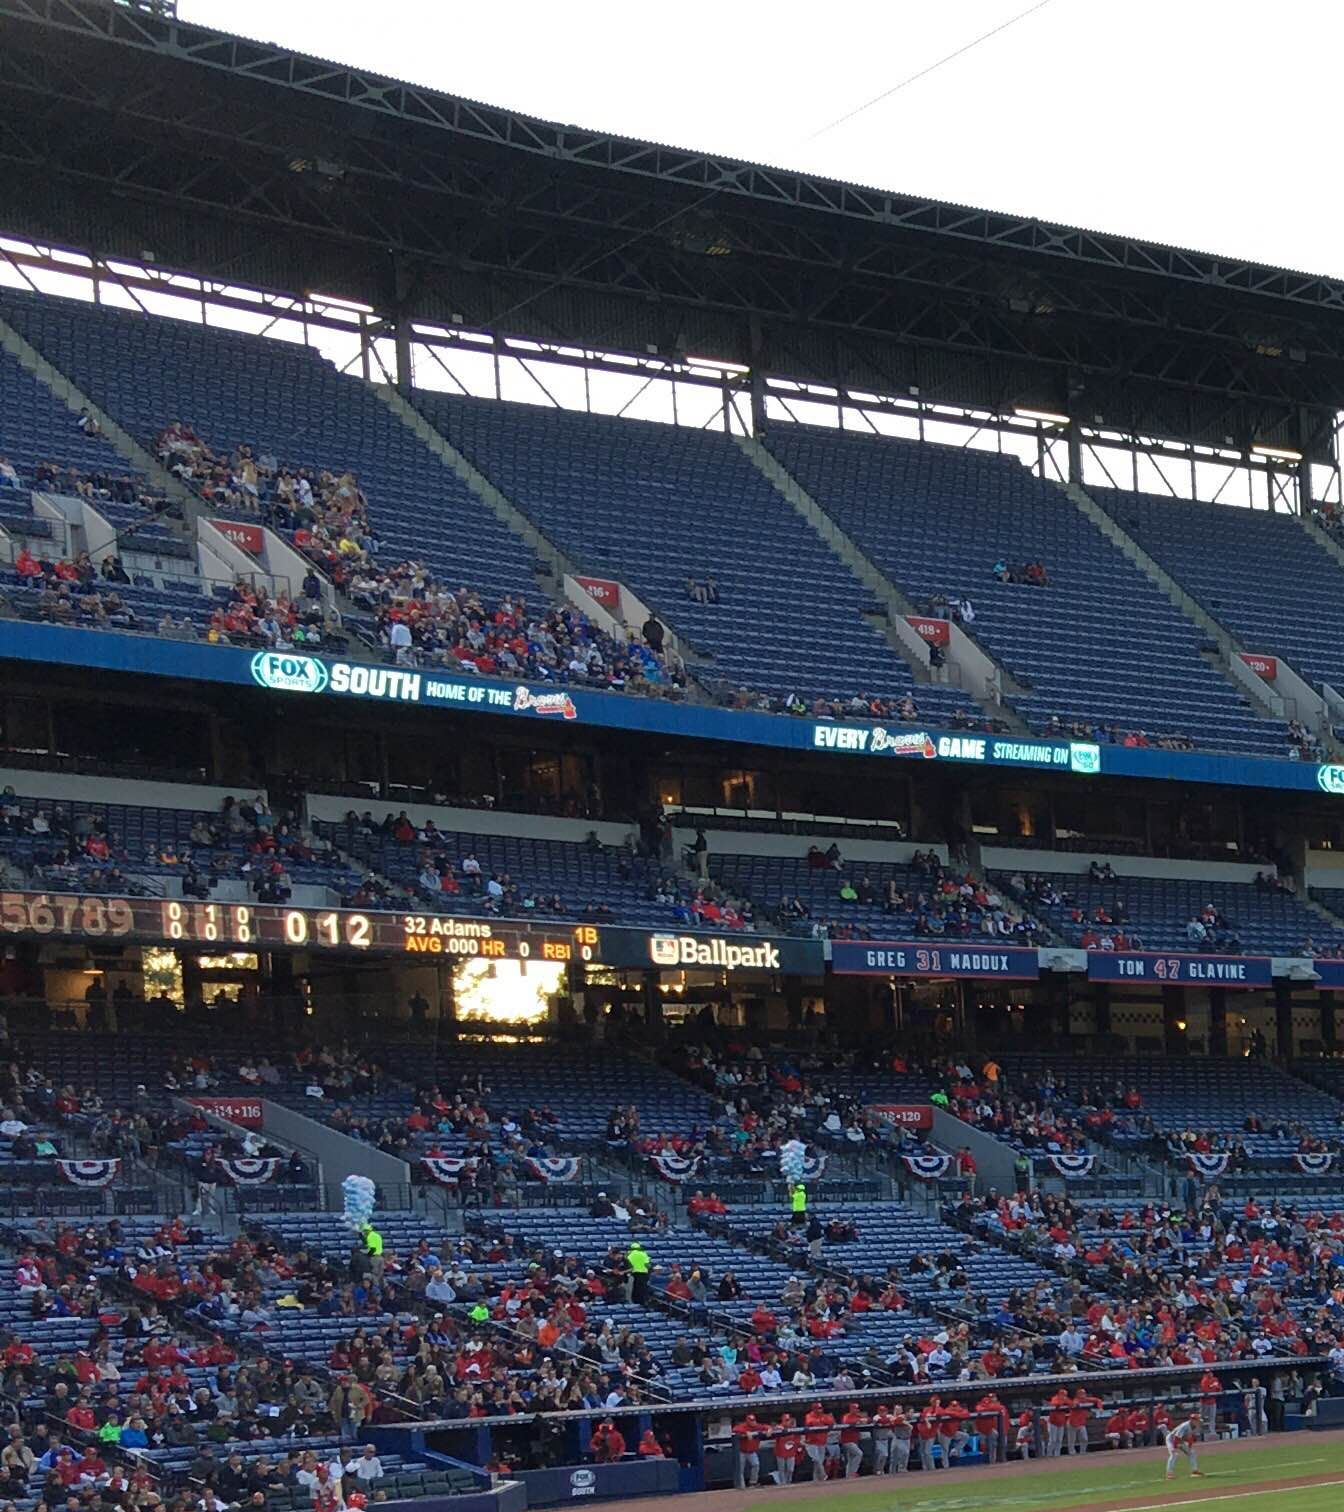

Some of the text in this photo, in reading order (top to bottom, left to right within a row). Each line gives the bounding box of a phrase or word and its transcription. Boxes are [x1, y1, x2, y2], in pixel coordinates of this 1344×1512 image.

[269, 656, 309, 679] FOX
[330, 663, 512, 706] SOUTH HOME OF THE
[814, 725, 1069, 764] EVERY GAME STREAMING ON
[404, 916, 492, 938] 32 Adams
[575, 927, 597, 945] 1B
[405, 936, 571, 960] AVG .000 HR 0 RBI
[679, 936, 780, 970] Ballpark
[866, 950, 1009, 972] GREG 31 MADDUX
[1117, 959, 1247, 980] TOM 47 GLAVINE
